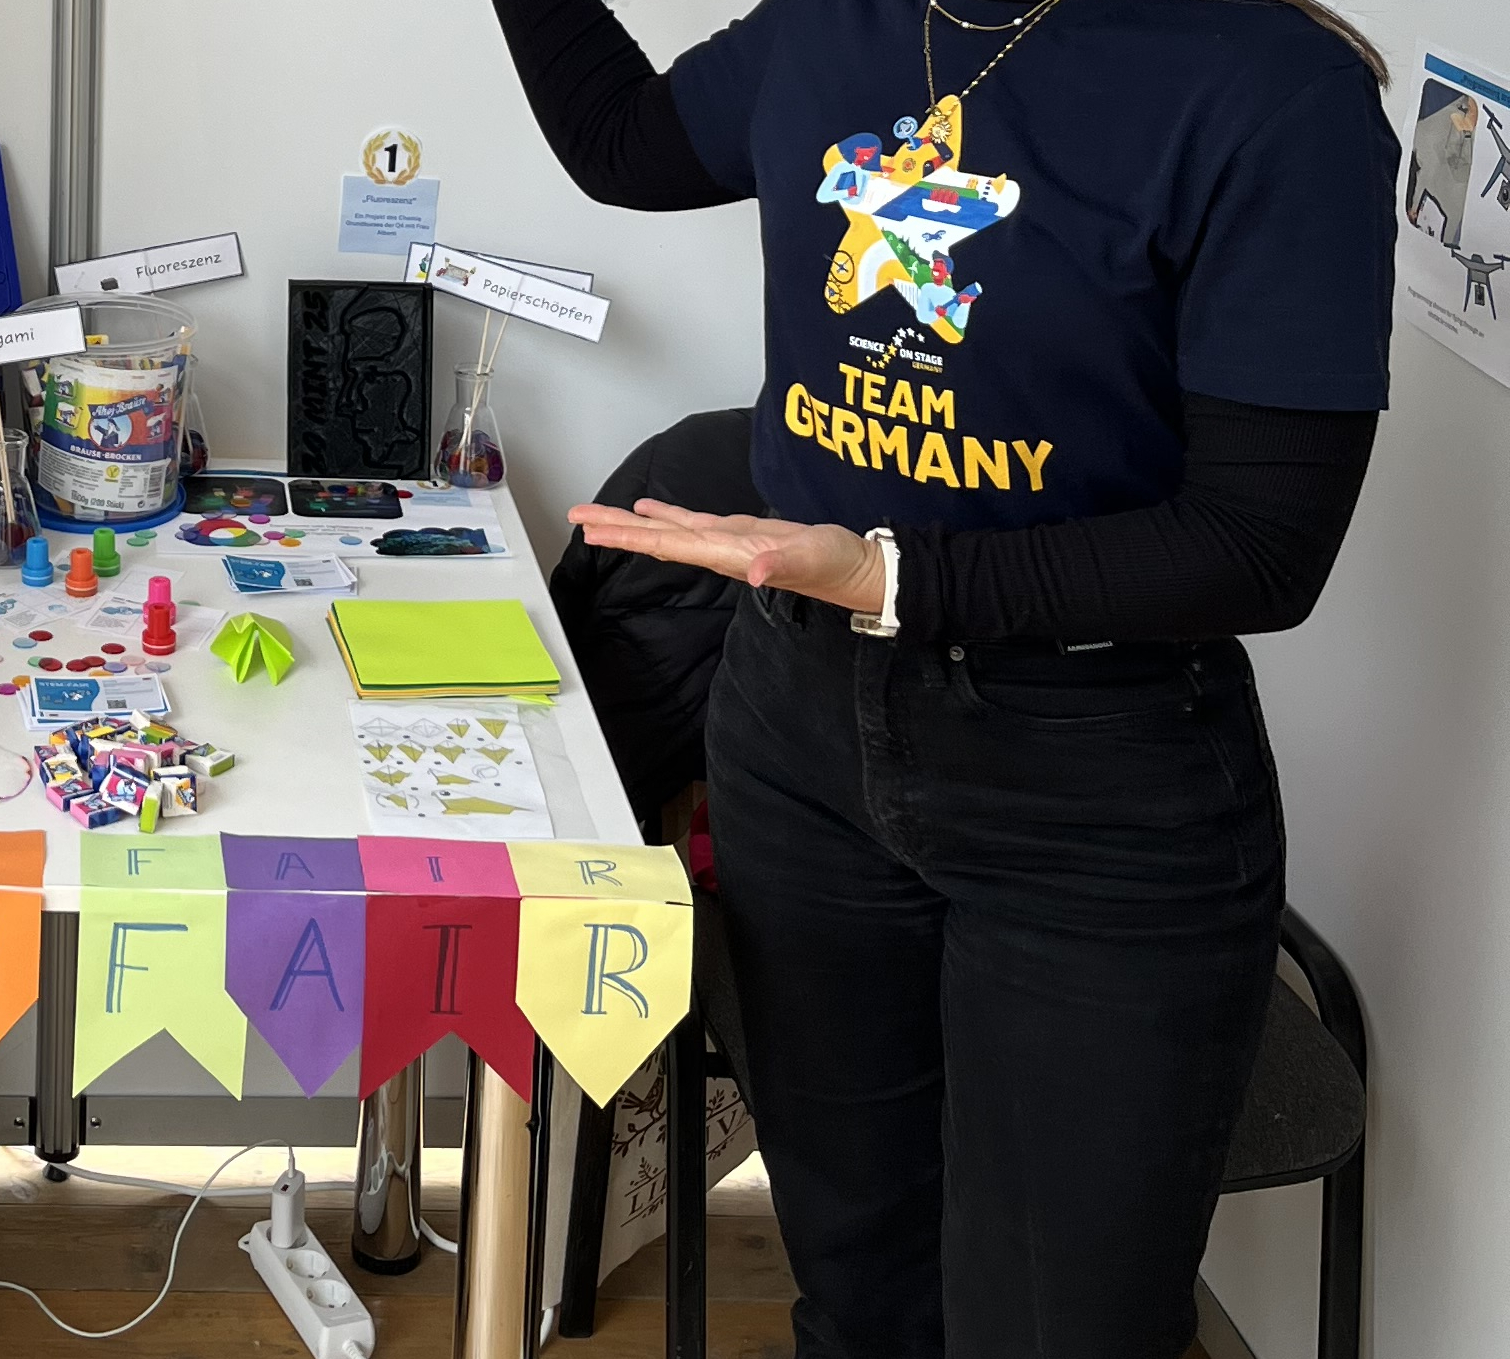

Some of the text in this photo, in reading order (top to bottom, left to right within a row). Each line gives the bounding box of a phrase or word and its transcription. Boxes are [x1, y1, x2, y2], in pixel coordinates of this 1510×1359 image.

[384, 143, 398, 173] 1
[135, 252, 222, 279] Fluoreszenz
[482, 278, 593, 325] Papierschöpfen
[848, 335, 943, 366] SCIENCE ON STAGE
[838, 362, 956, 430] TEAM
[785, 382, 1054, 492] GERMANY
